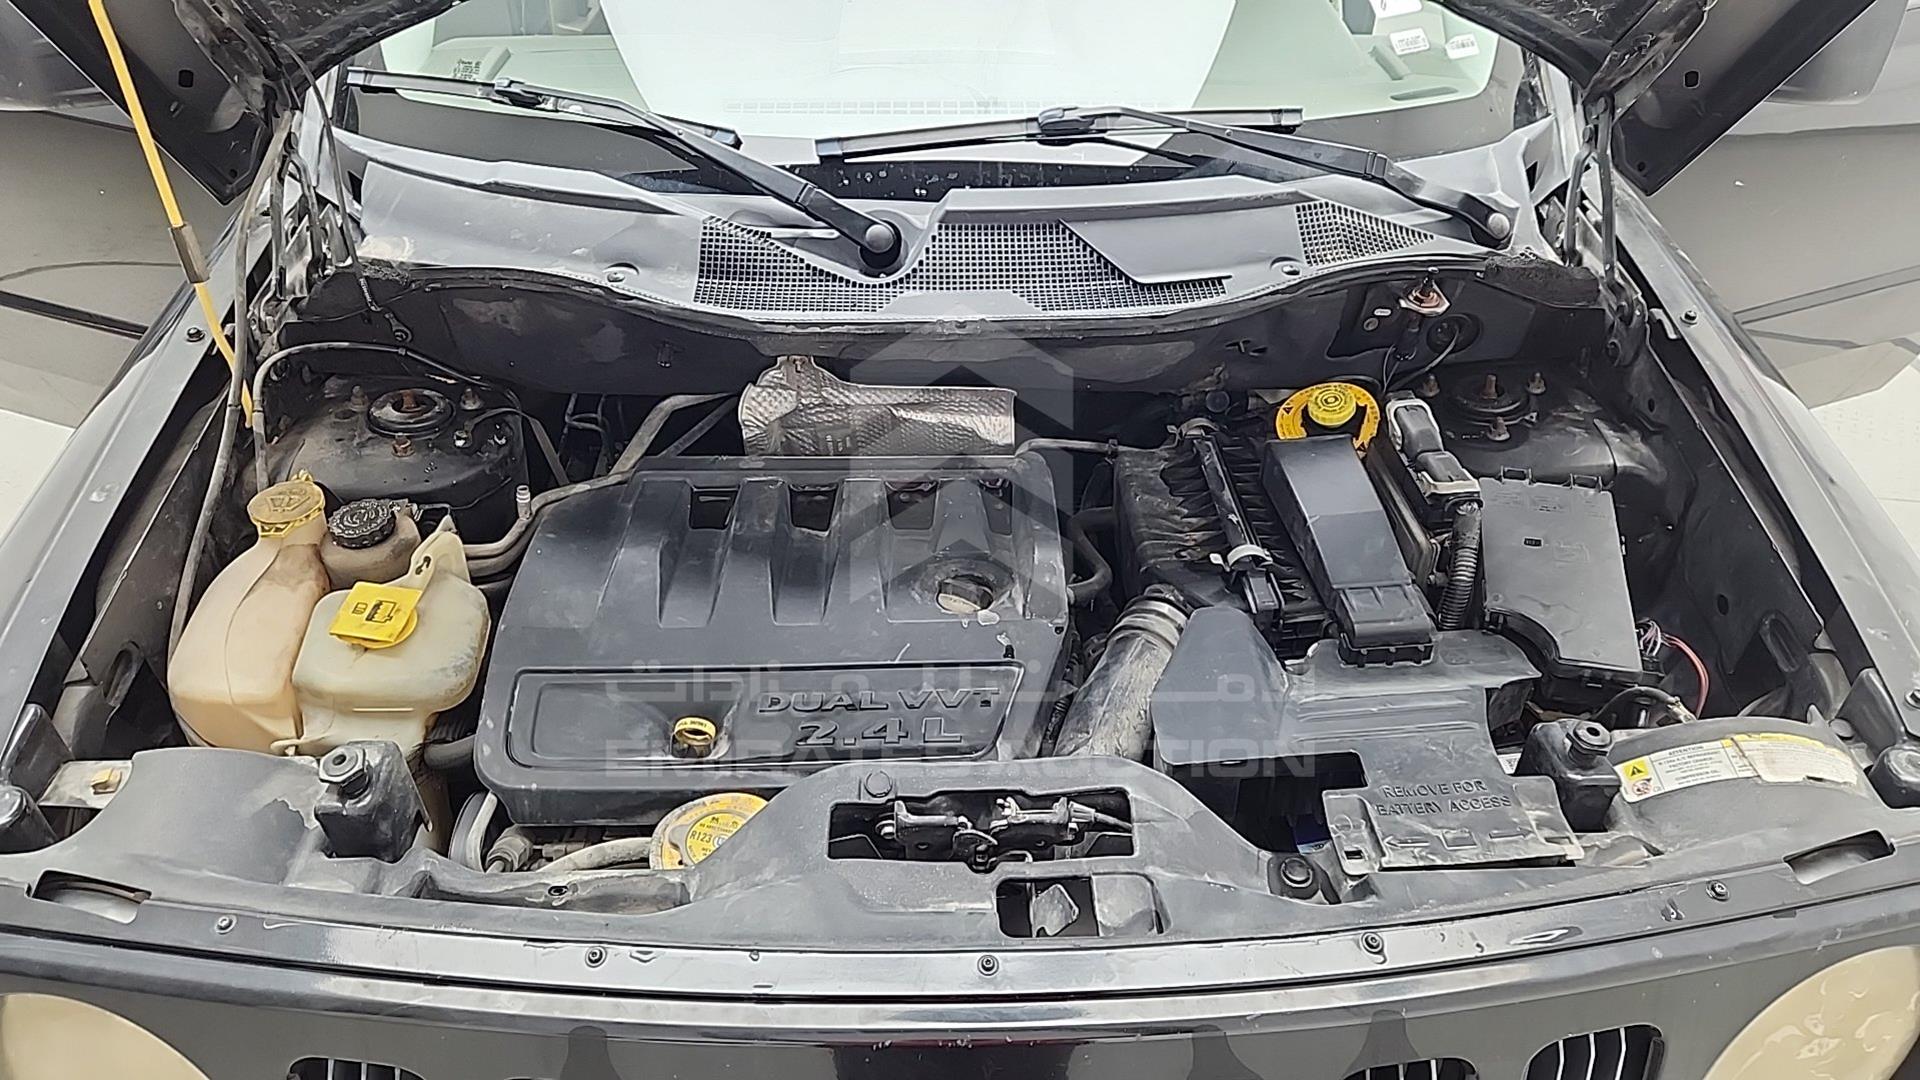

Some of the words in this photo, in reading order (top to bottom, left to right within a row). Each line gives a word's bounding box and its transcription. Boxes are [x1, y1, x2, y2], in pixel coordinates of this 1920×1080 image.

[758, 690, 889, 713] DUAL
[898, 687, 1000, 710] VVT
[1382, 783, 1450, 798] REMOVE
[1452, 779, 1488, 794] FOR
[1450, 795, 1512, 812] ACCESS
